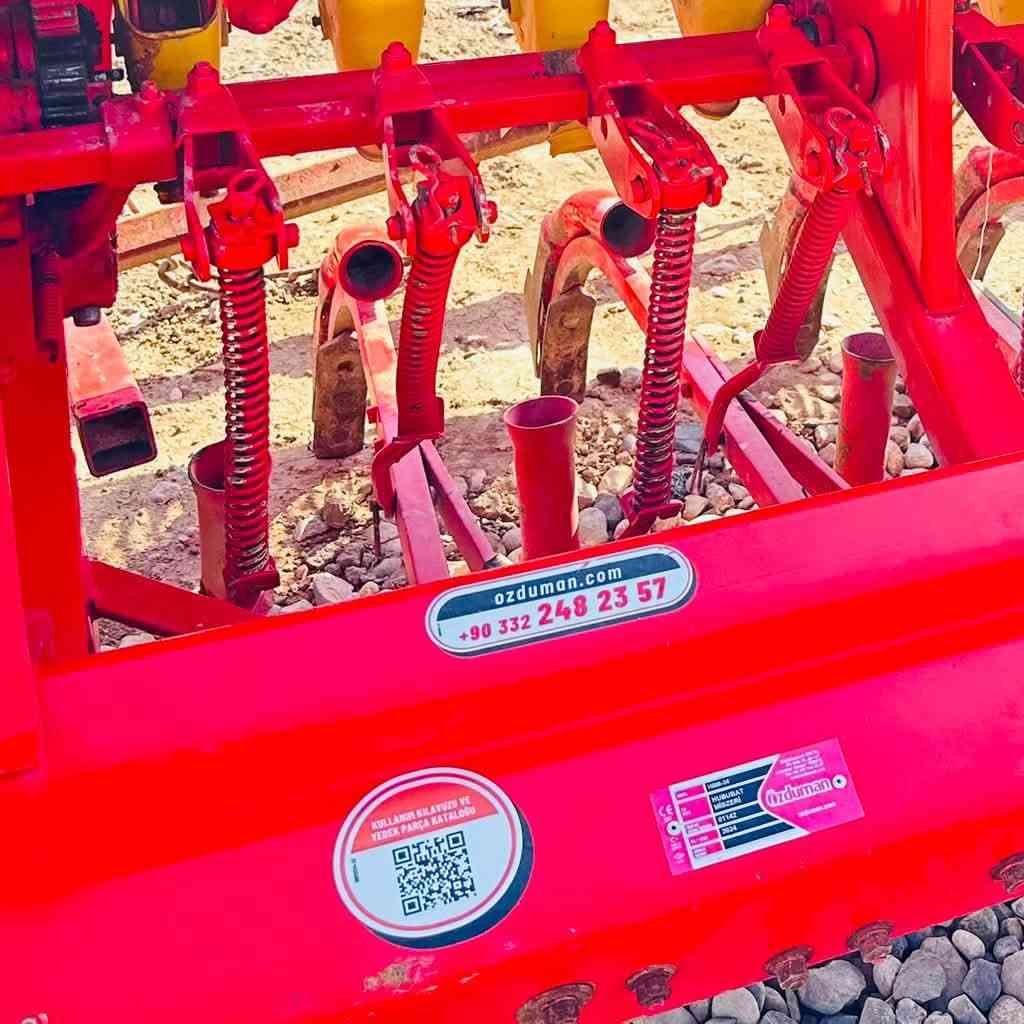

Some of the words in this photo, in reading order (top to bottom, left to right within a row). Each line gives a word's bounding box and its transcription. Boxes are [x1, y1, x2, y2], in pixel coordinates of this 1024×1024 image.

[459, 623, 492, 642] +90
[498, 614, 531, 635] 332
[538, 595, 588, 627] 248
[596, 585, 628, 613] 23
[636, 577, 667, 603] 57
[494, 566, 622, 605] ozduman.com
